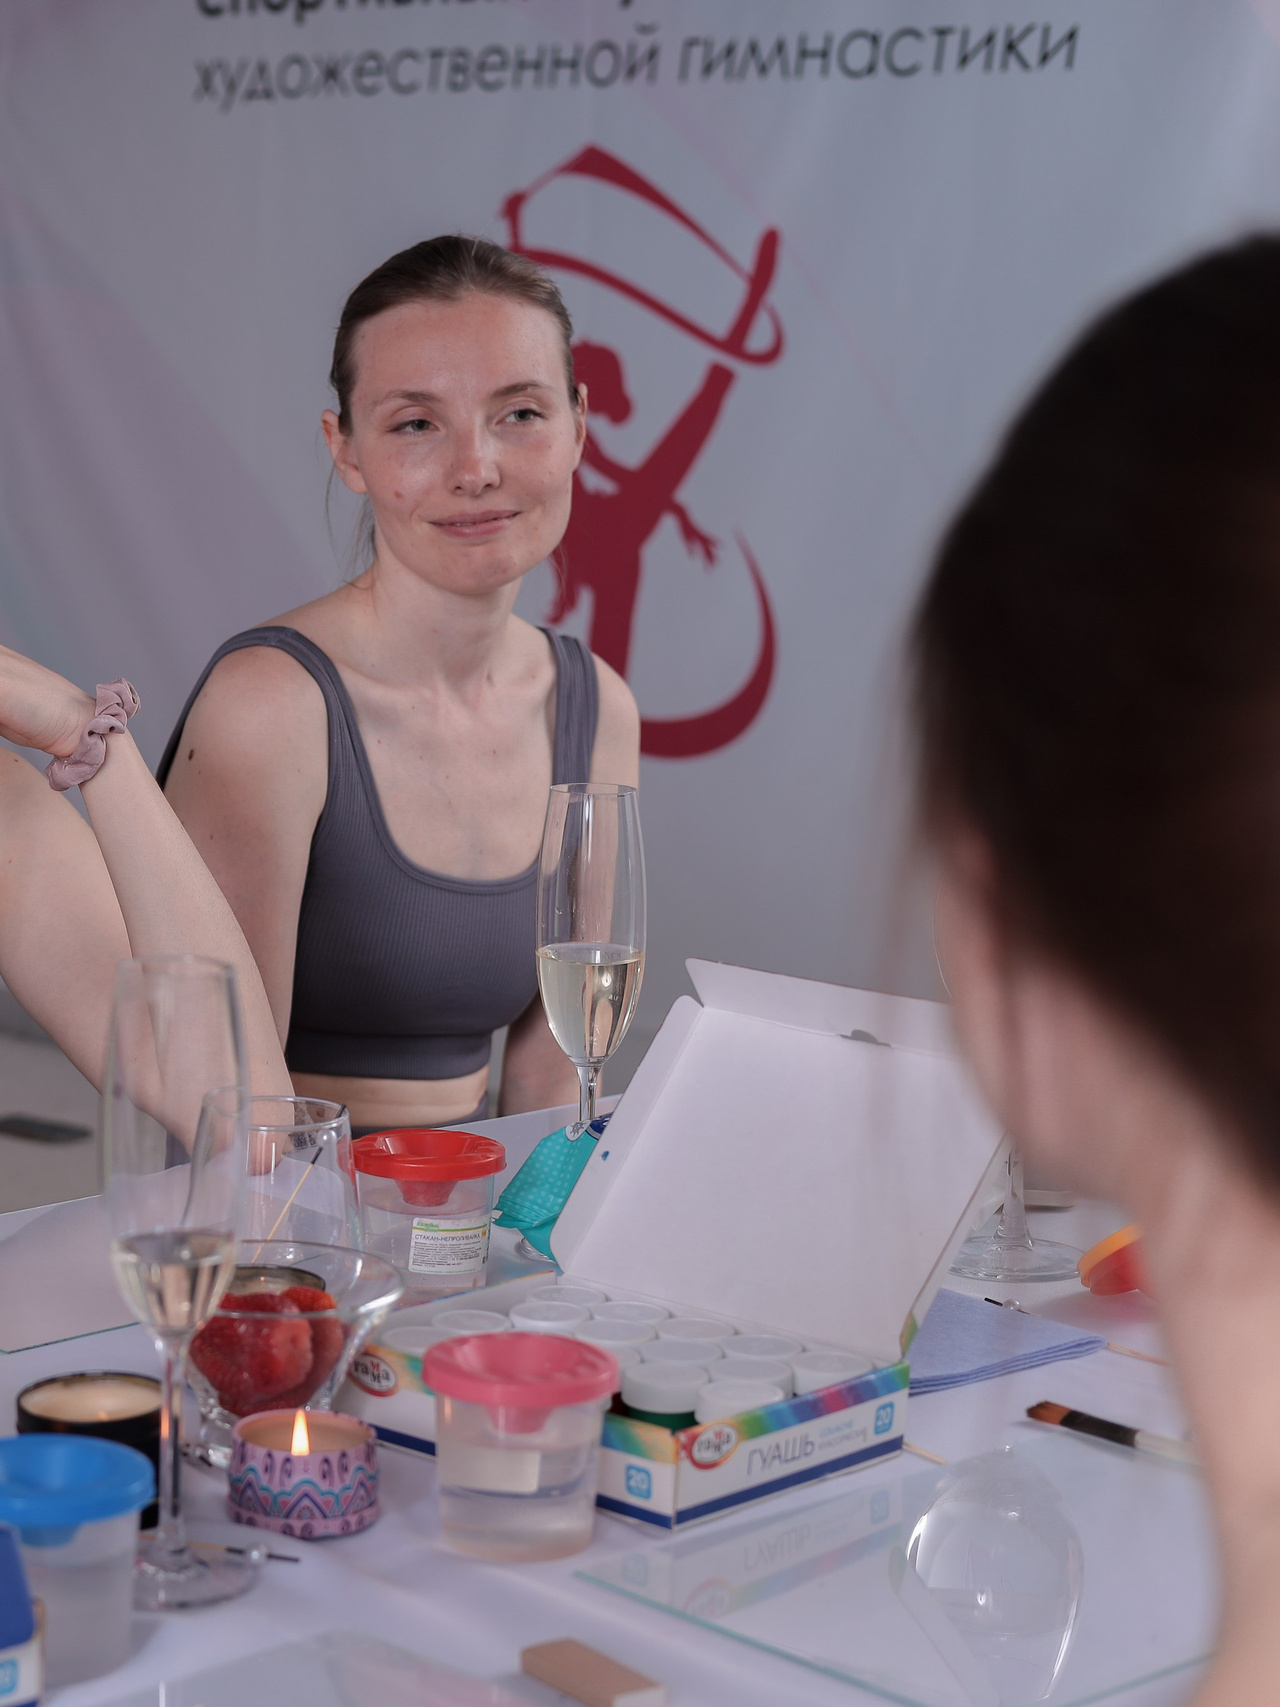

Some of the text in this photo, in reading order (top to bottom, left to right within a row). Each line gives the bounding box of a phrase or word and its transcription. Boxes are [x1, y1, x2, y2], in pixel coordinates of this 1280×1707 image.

[194, 22, 1080, 113] художественной гимнастики
[876, 1406, 892, 1426] 20
[746, 1434, 816, 1476] ГУАШЬ
[628, 1469, 648, 1491] 20
